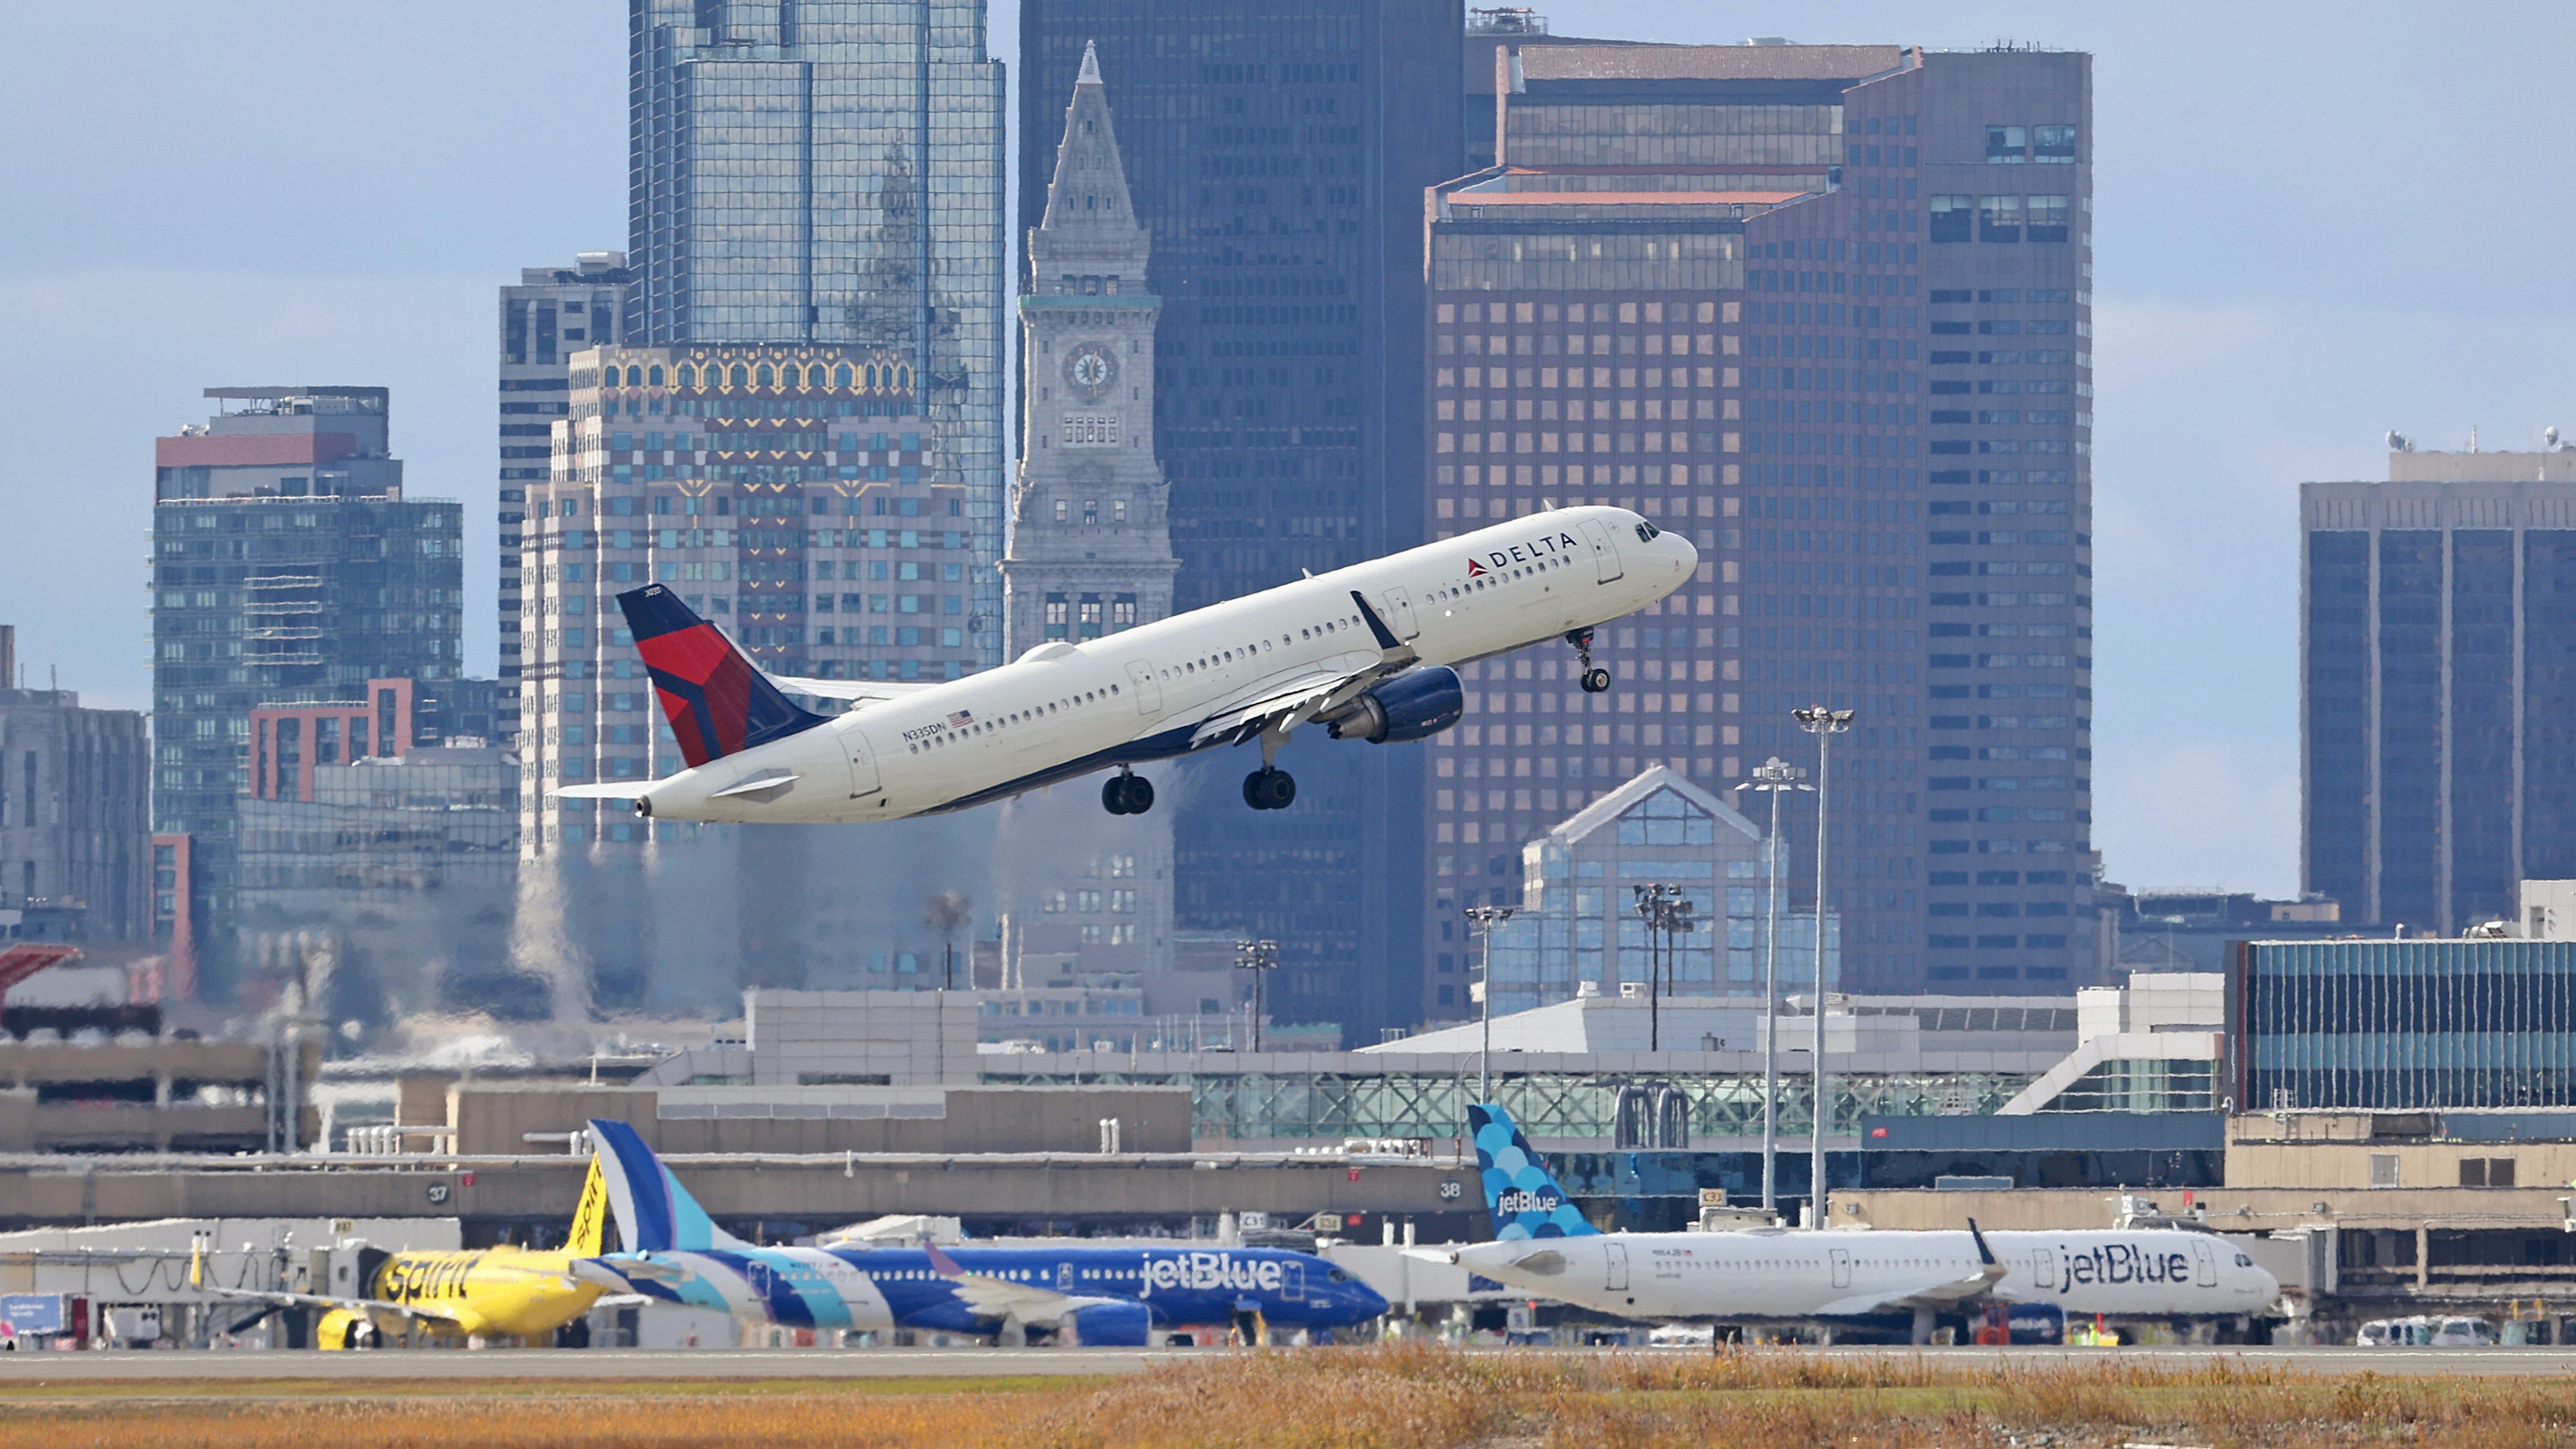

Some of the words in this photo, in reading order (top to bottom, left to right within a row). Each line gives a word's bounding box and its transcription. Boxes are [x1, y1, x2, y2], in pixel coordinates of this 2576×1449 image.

[1489, 533, 1577, 567] DELTA
[901, 722, 947, 742] N335DN
[428, 1186, 447, 1201] 37
[577, 1155, 602, 1251] spiri
[1440, 1183, 1460, 1198] 38
[1497, 1191, 1557, 1217] jetBlue
[386, 1253, 480, 1306] spirit
[1139, 1252, 1281, 1299] jetBlue
[2060, 1244, 2189, 1294] jetBlue
